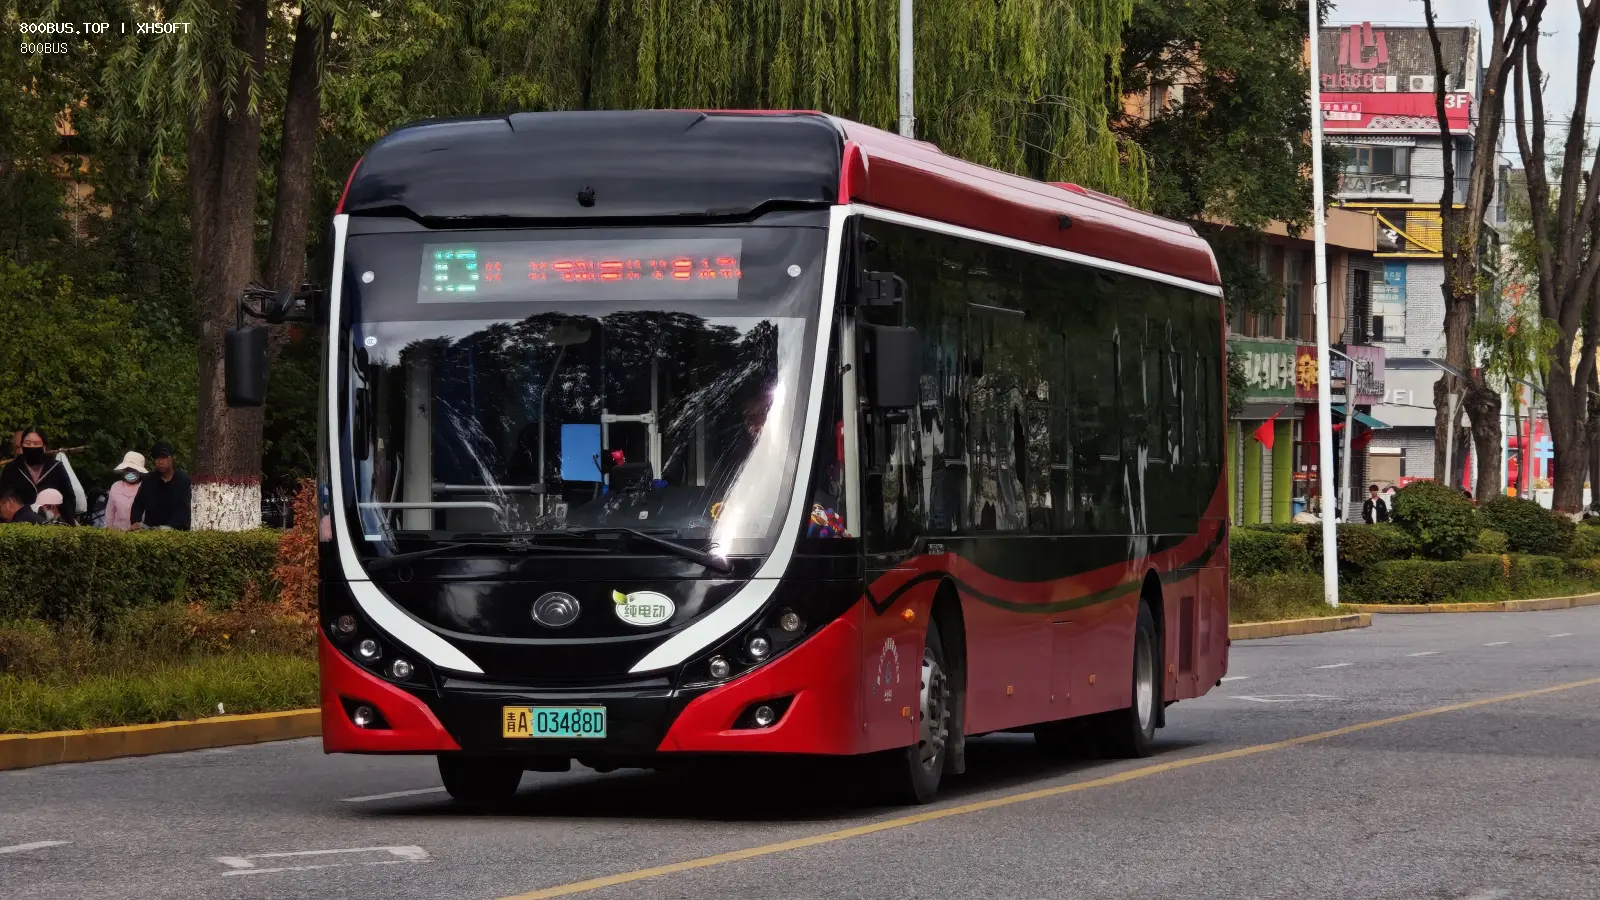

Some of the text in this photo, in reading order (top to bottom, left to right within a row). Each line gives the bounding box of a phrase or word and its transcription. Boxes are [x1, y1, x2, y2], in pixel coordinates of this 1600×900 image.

[1445, 95, 1468, 109] 3F
[623, 604, 666, 618] 纯电动
[537, 711, 604, 733] 03488D
